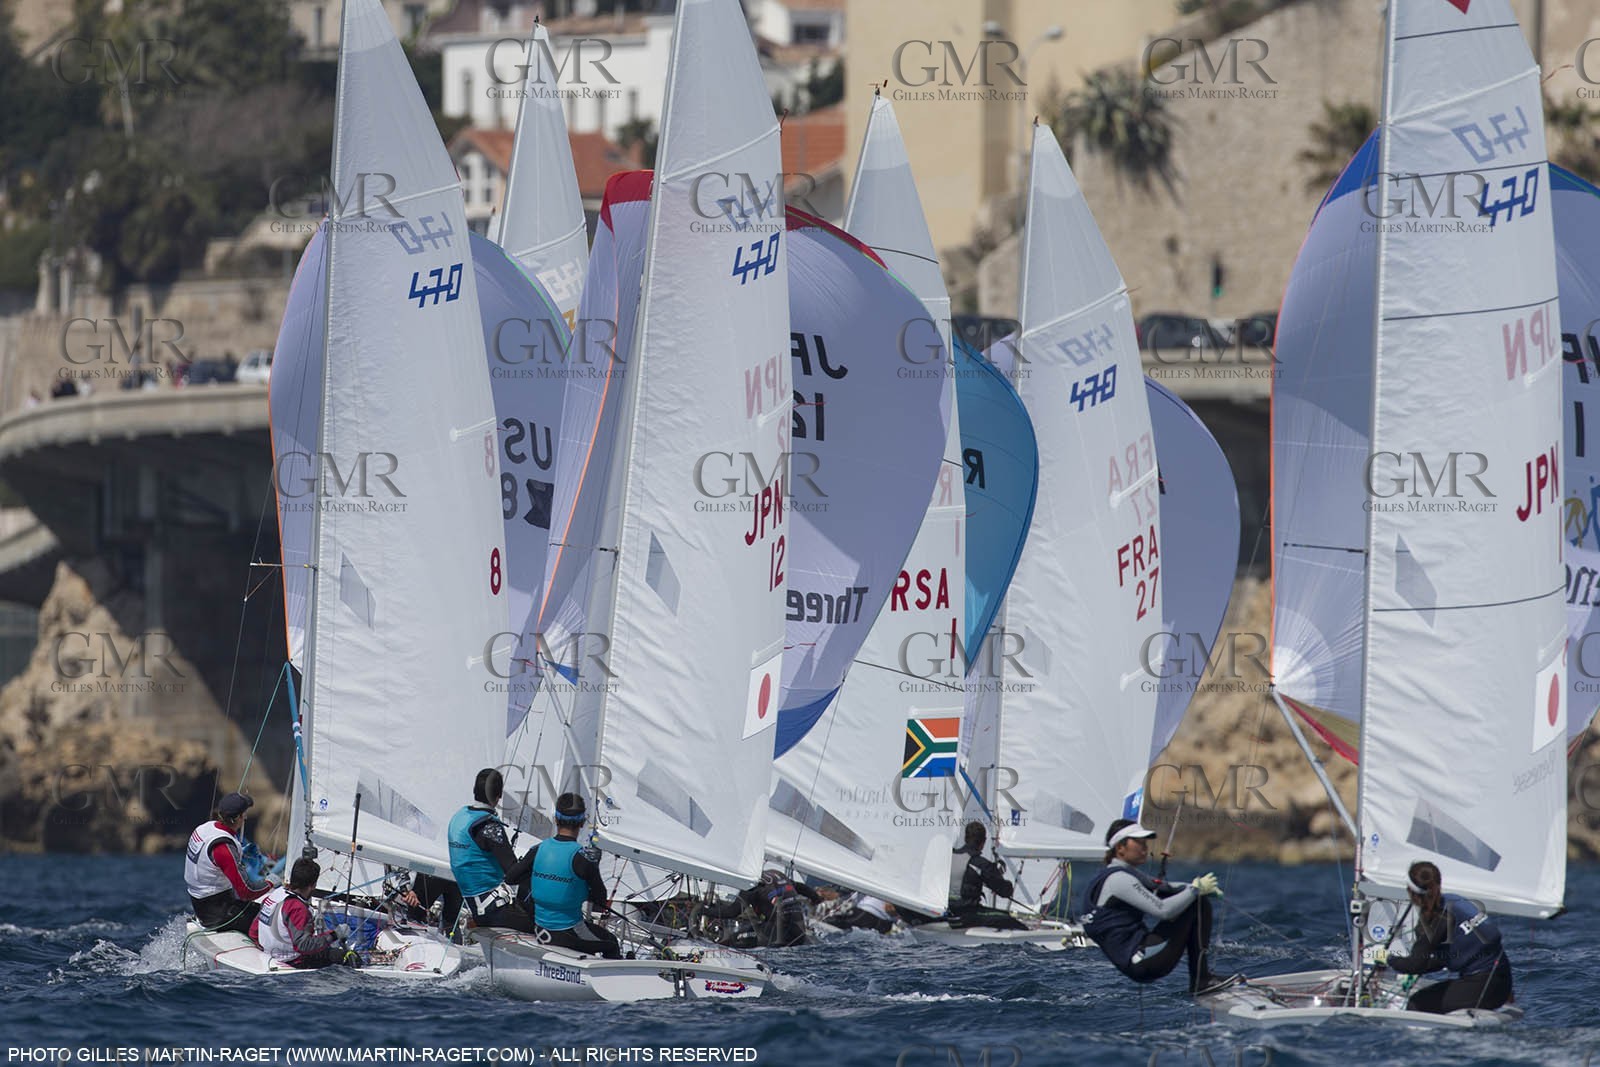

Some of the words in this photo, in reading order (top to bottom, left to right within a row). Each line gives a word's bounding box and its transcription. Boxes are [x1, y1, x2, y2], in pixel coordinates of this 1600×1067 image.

[1478, 167, 1539, 227] 470
[408, 263, 463, 308] 470
[732, 232, 780, 285] 470
[1069, 364, 1117, 412] 470
[1516, 440, 1559, 522] JPN
[744, 475, 785, 546] JPN
[490, 547, 502, 596] 8
[769, 535, 785, 593] 12
[1117, 525, 1159, 587] FRA
[891, 567, 950, 612] RSA
[1136, 567, 1159, 631] 27
[539, 961, 582, 984] ThreeBond
